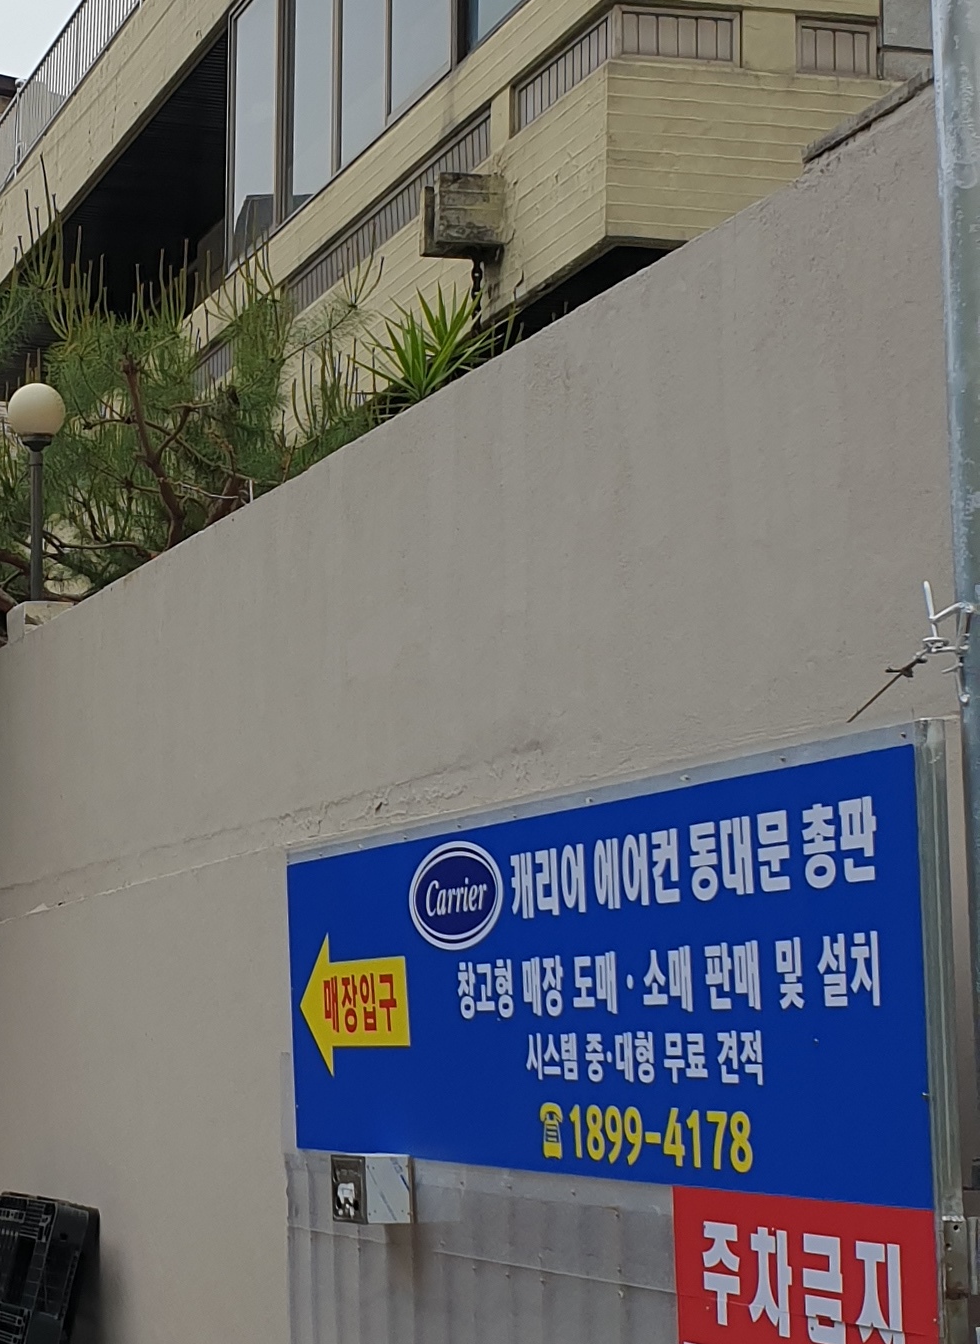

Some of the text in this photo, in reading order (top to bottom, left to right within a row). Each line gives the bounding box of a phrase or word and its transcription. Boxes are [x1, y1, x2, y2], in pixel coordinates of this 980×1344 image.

[510, 795, 877, 919] 캐리어 에어컨 동대문 총판
[425, 877, 488, 917] Carrier
[323, 972, 398, 1034] 매장입구
[457, 958, 514, 1020] 창고형
[522, 955, 564, 1017] 매장
[704, 939, 762, 1010] 판매
[775, 936, 805, 1009] 및
[817, 930, 881, 1006] 설치
[526, 1032, 579, 1081] 시스템
[663, 1032, 709, 1084] 무료
[717, 1029, 764, 1086] 견적
[569, 1104, 754, 1173] 1899-4178
